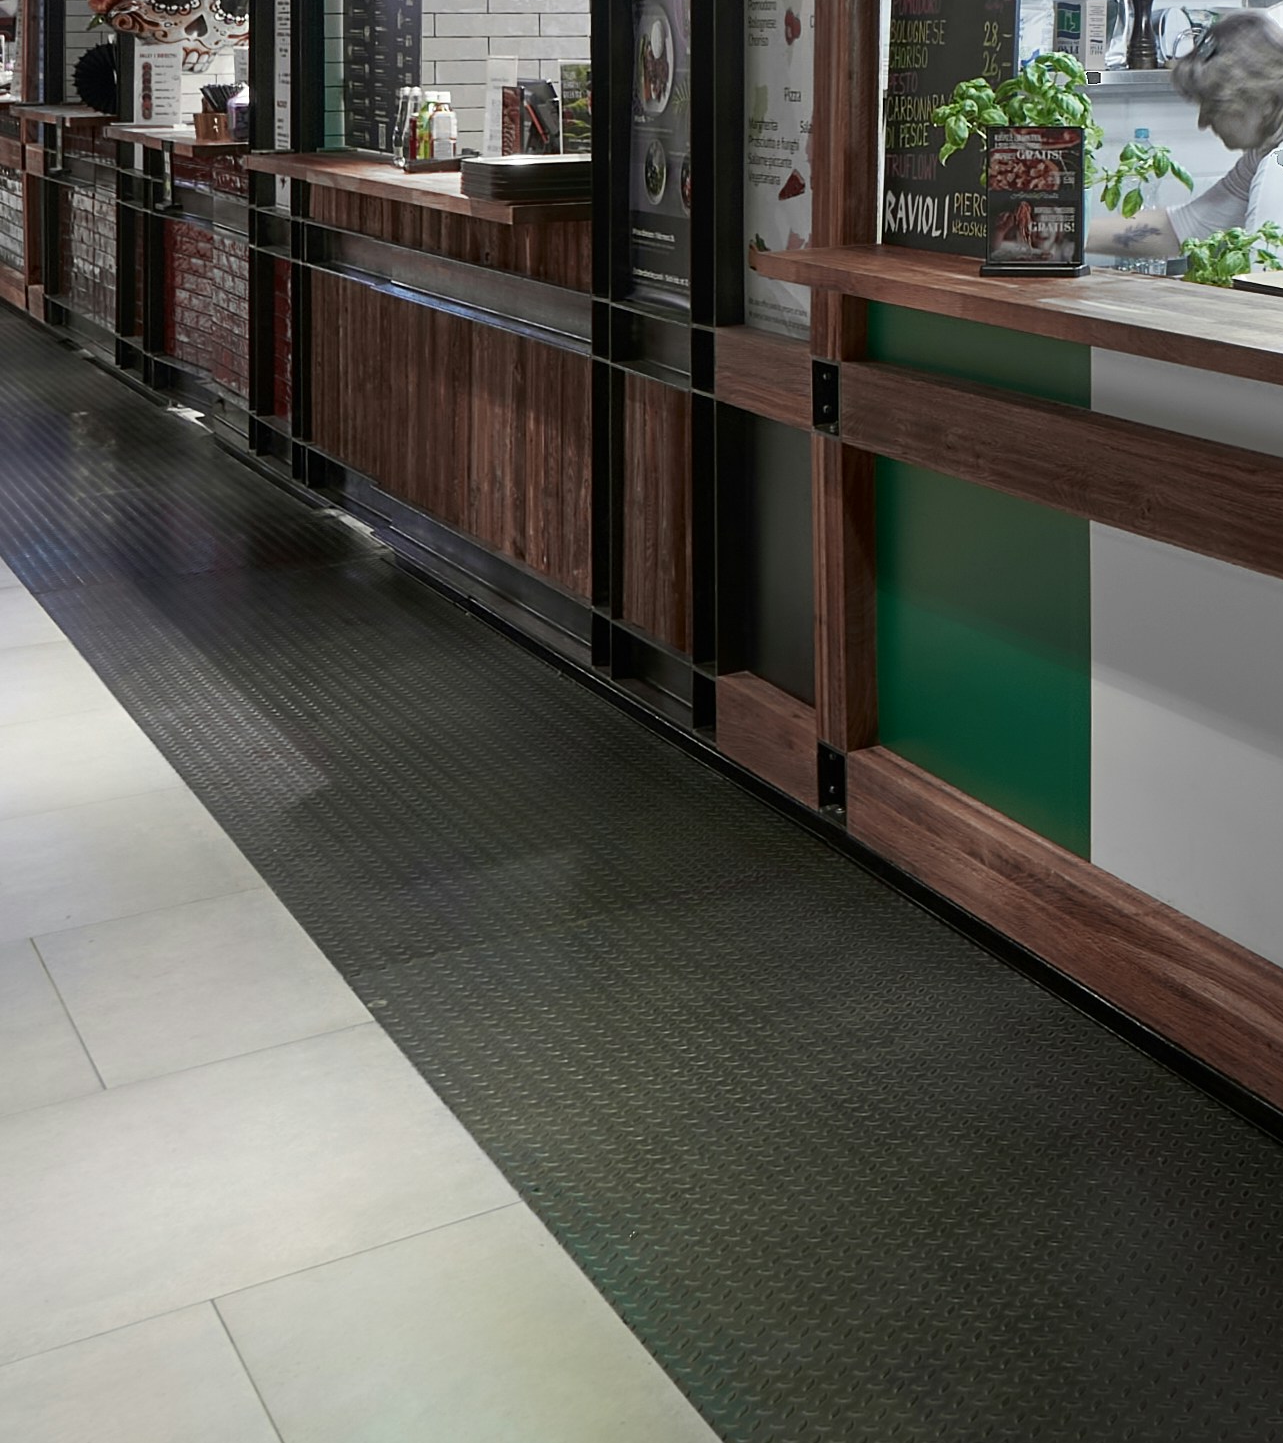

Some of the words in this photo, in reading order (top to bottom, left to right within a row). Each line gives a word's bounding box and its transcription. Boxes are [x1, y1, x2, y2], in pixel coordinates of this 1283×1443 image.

[890, 20, 946, 45] BOLOGNESE
[888, 46, 928, 69] CHORISO
[900, 122, 930, 148] PESCE
[885, 190, 950, 239] RAVIOLI
